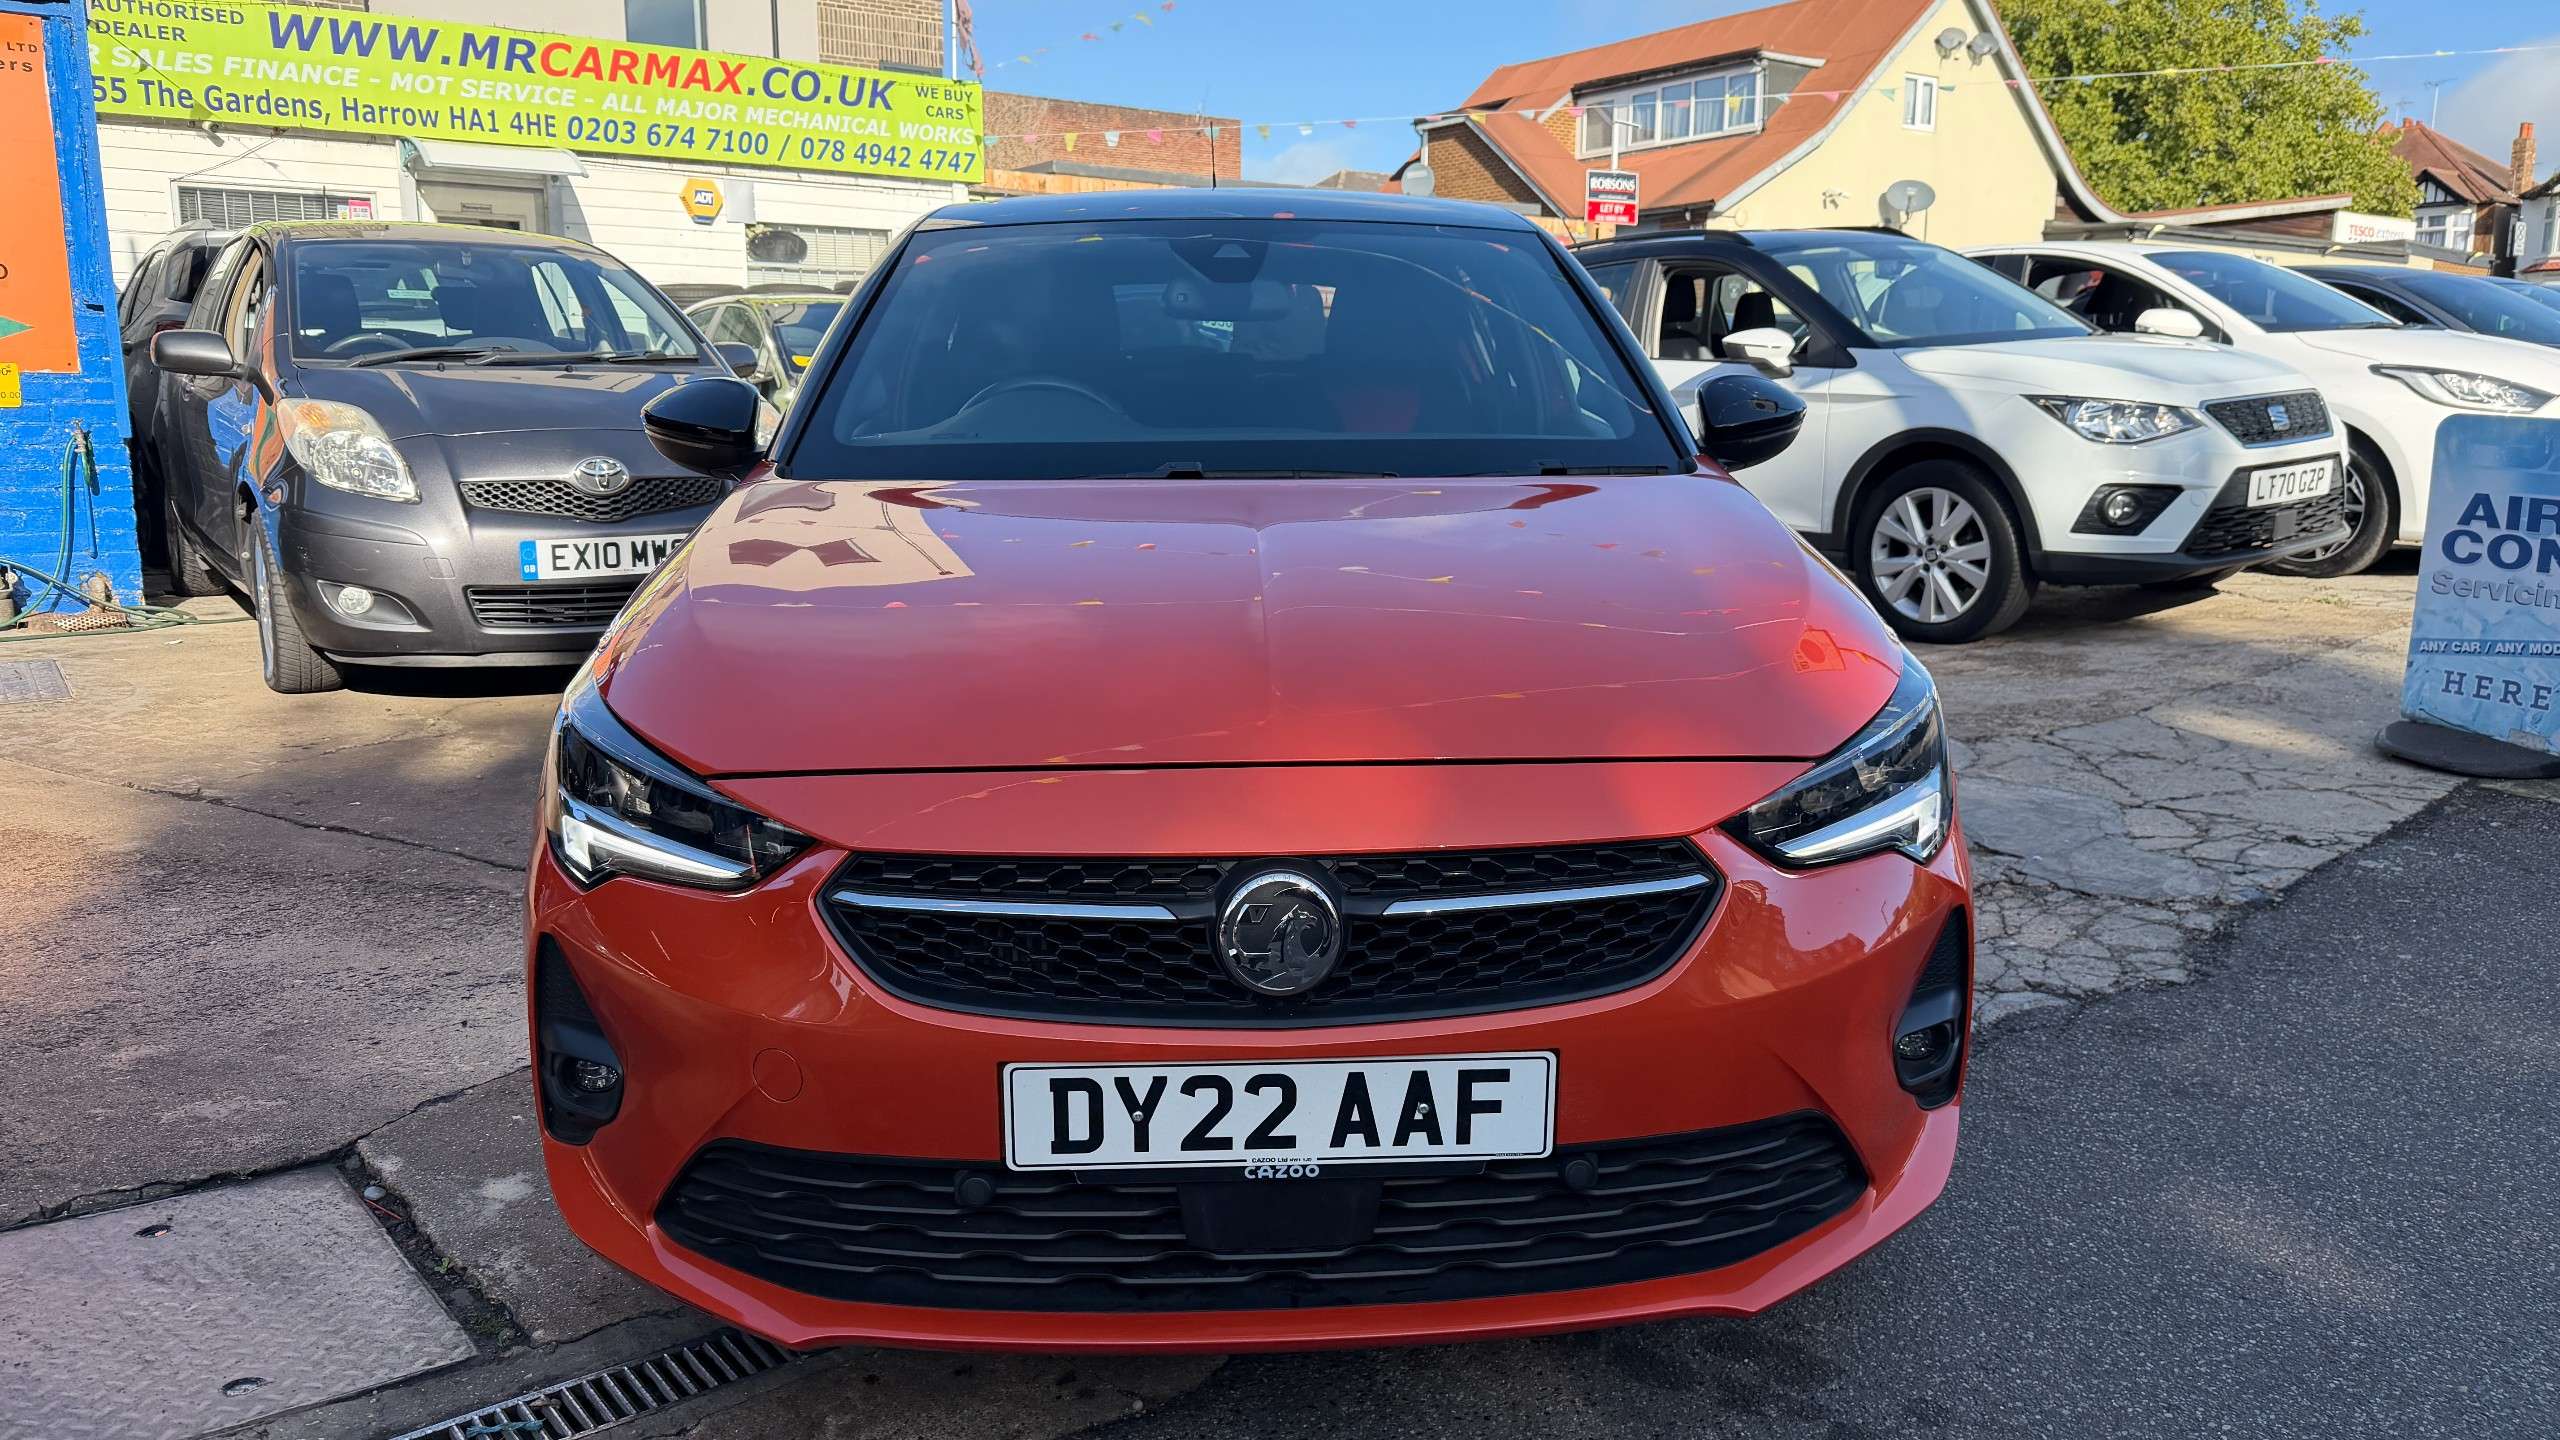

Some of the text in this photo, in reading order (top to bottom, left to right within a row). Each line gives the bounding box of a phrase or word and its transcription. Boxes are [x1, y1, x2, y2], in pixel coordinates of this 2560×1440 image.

[90, 0, 245, 25] AUTHORISED
[95, 19, 188, 42] DEALER
[6, 41, 38, 53] LTD
[268, 11, 897, 111] WWW.MRCARMAX.CO.UK
[111, 46, 213, 75] SALES
[223, 56, 360, 88] FINANCE
[390, 72, 454, 96] MOT
[460, 78, 577, 107] SERVICE
[601, 92, 647, 114] ALL
[655, 96, 738, 122] MAJOR
[745, 106, 891, 137] MECHANICAL
[899, 121, 976, 146] WORKS
[915, 85, 973, 103] WE BUY
[925, 105, 964, 120] CARS
[137, 78, 194, 109] The
[203, 84, 331, 126] Gardens,
[341, 96, 439, 128] Harrow
[449, 105, 499, 133] HA1
[510, 111, 557, 138] 4HE
[567, 115, 636, 144] 0203
[647, 122, 695, 149] 674
[705, 128, 769, 155] 7100
[777, 134, 791, 161] /
[801, 136, 846, 162] 078
[853, 142, 911, 168] 4942
[919, 149, 976, 174] 4747
[1590, 177, 1635, 190] ROBSONS
[695, 190, 713, 205] ADT
[1599, 203, 1613, 213] LET
[2349, 224, 2375, 237] TESCO
[2300, 467, 2325, 493] GZP
[2456, 492, 2560, 536] AIR
[551, 541, 621, 571] EX10
[2441, 529, 2560, 574] CON
[523, 565, 536, 573] GB
[2419, 641, 2448, 654] ANY
[2451, 642, 2481, 655] CAR
[2495, 643, 2526, 656] ANY
[2441, 669, 2553, 711] HERE
[1049, 1068, 1511, 1155] DY22 AAF
[1244, 1164, 1320, 1179] CAZOO
